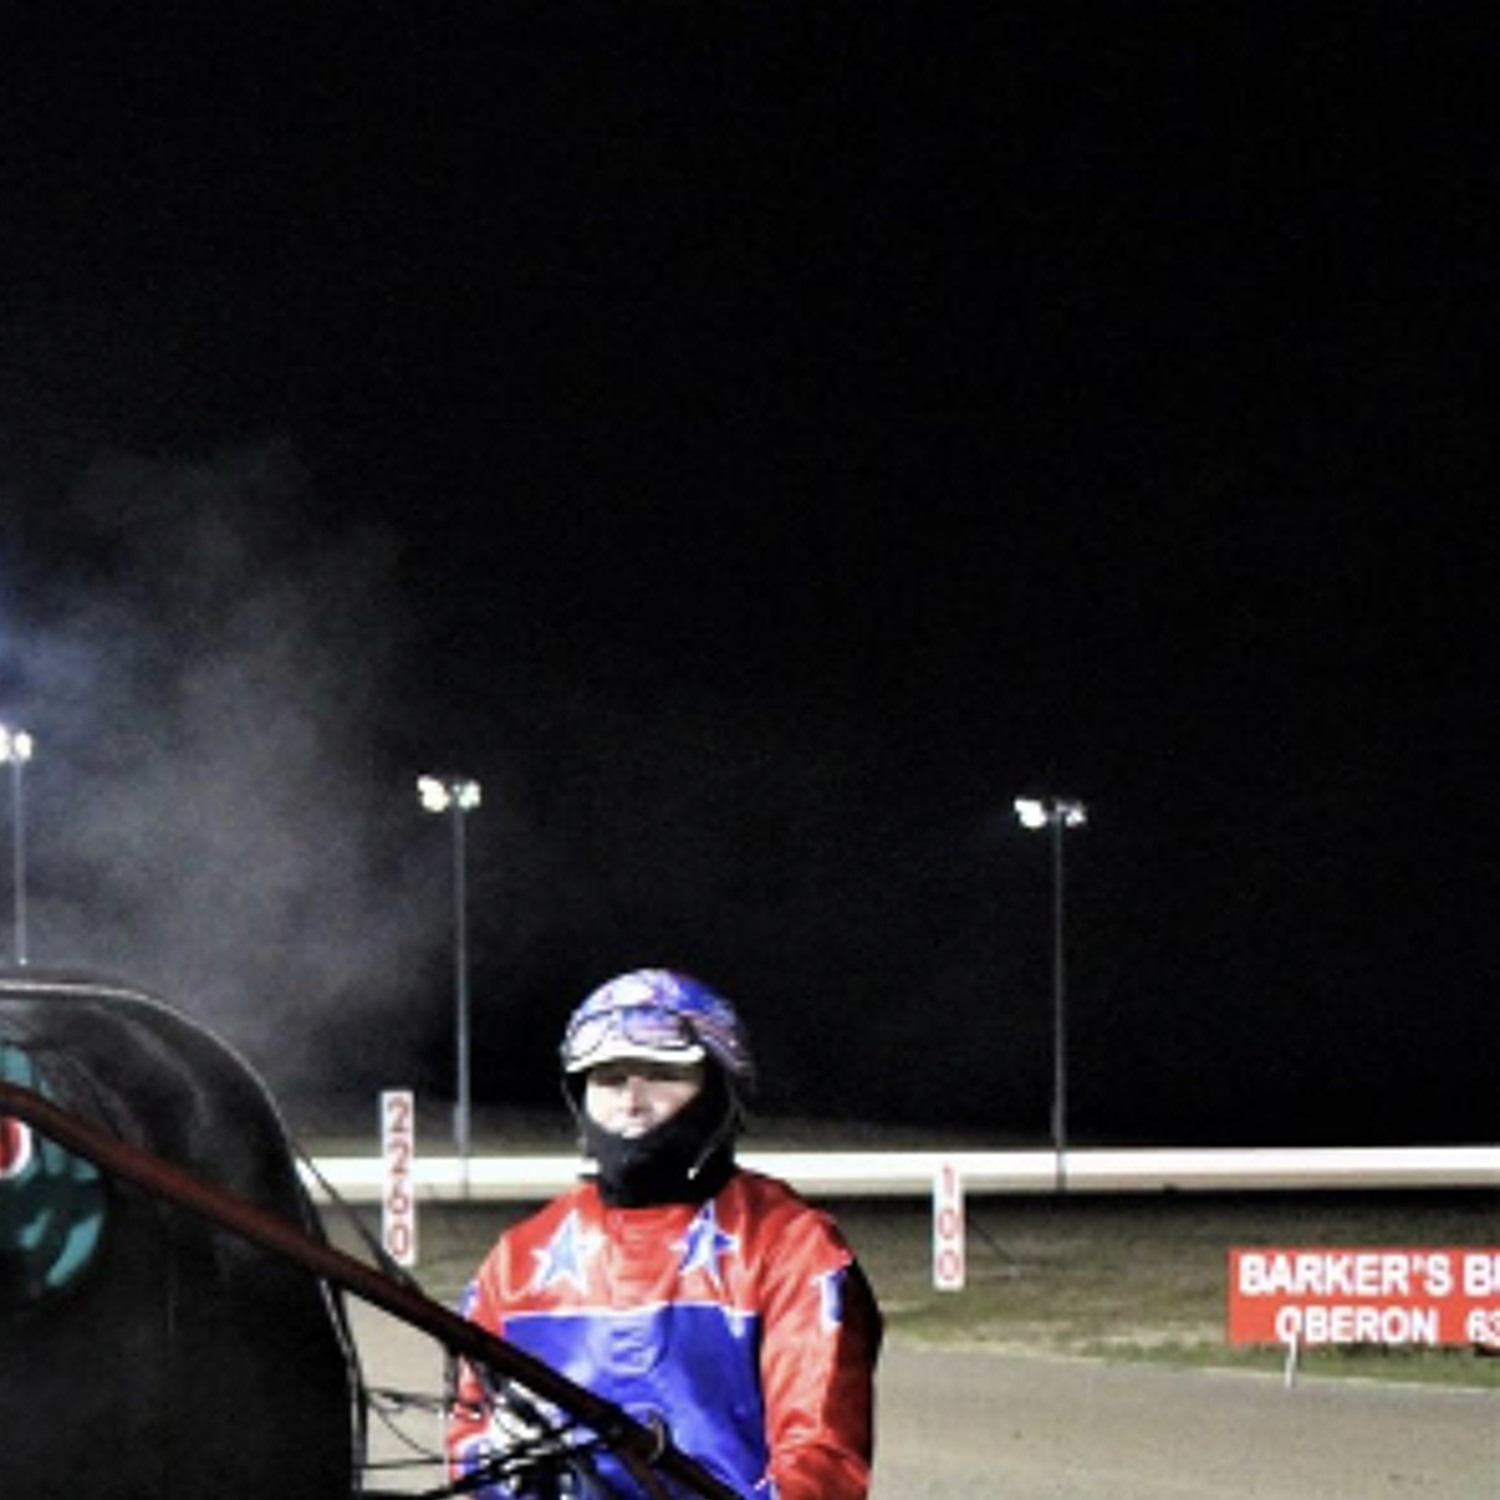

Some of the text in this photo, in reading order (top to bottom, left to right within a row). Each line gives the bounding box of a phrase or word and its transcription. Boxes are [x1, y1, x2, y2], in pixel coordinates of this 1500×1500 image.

[937, 1164, 962, 1282] 100
[1239, 1253, 1500, 1297] BARKER'S B
[1274, 1306, 1439, 1344] OBERON
